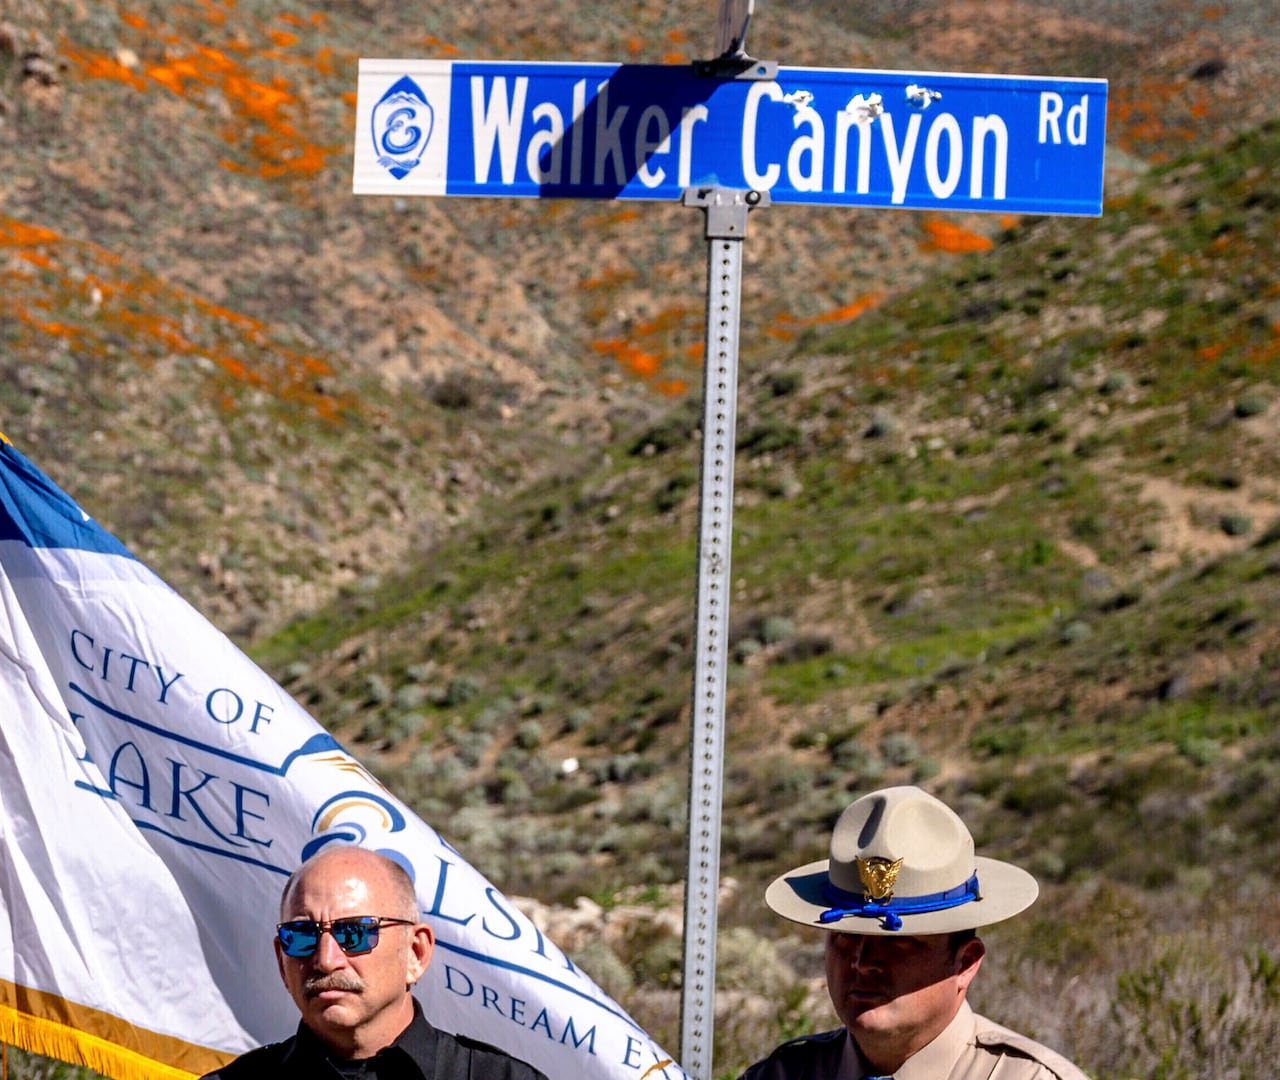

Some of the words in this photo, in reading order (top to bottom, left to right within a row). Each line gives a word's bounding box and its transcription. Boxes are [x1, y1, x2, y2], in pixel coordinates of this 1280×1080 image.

[471, 75, 708, 187] Walker
[742, 81, 1009, 204] Canyon
[1039, 91, 1089, 147] Rd
[69, 629, 185, 706] CITY
[206, 687, 275, 735] OF
[69, 711, 274, 849] AKE
[444, 964, 598, 1056] DREAM
